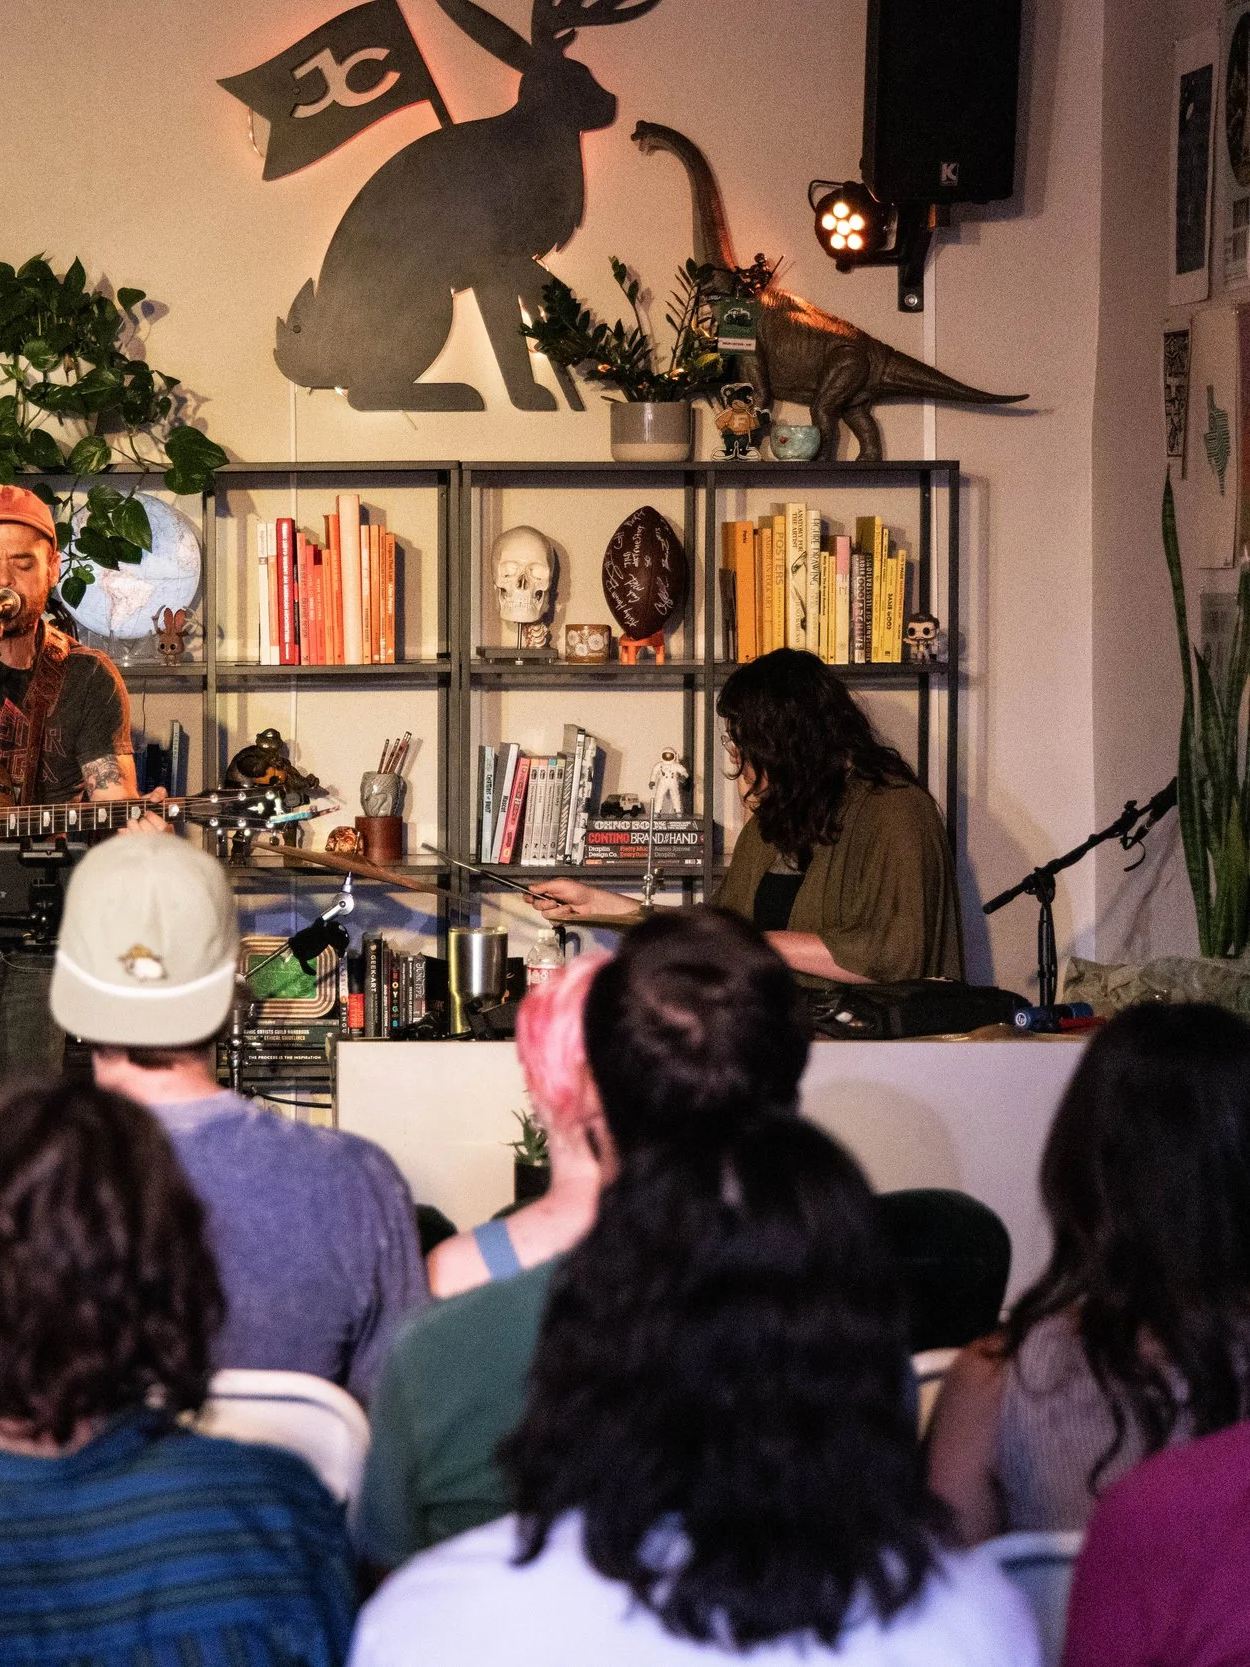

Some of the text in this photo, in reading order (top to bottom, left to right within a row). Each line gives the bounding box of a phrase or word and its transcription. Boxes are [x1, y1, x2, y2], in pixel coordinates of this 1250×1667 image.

[811, 518, 821, 545] FIGURE
[775, 532, 784, 585] POSTERS
[810, 547, 820, 585] DRAWING
[588, 832, 630, 844] CONTINO
[630, 832, 664, 844] BRAND
[669, 832, 698, 844] HAND
